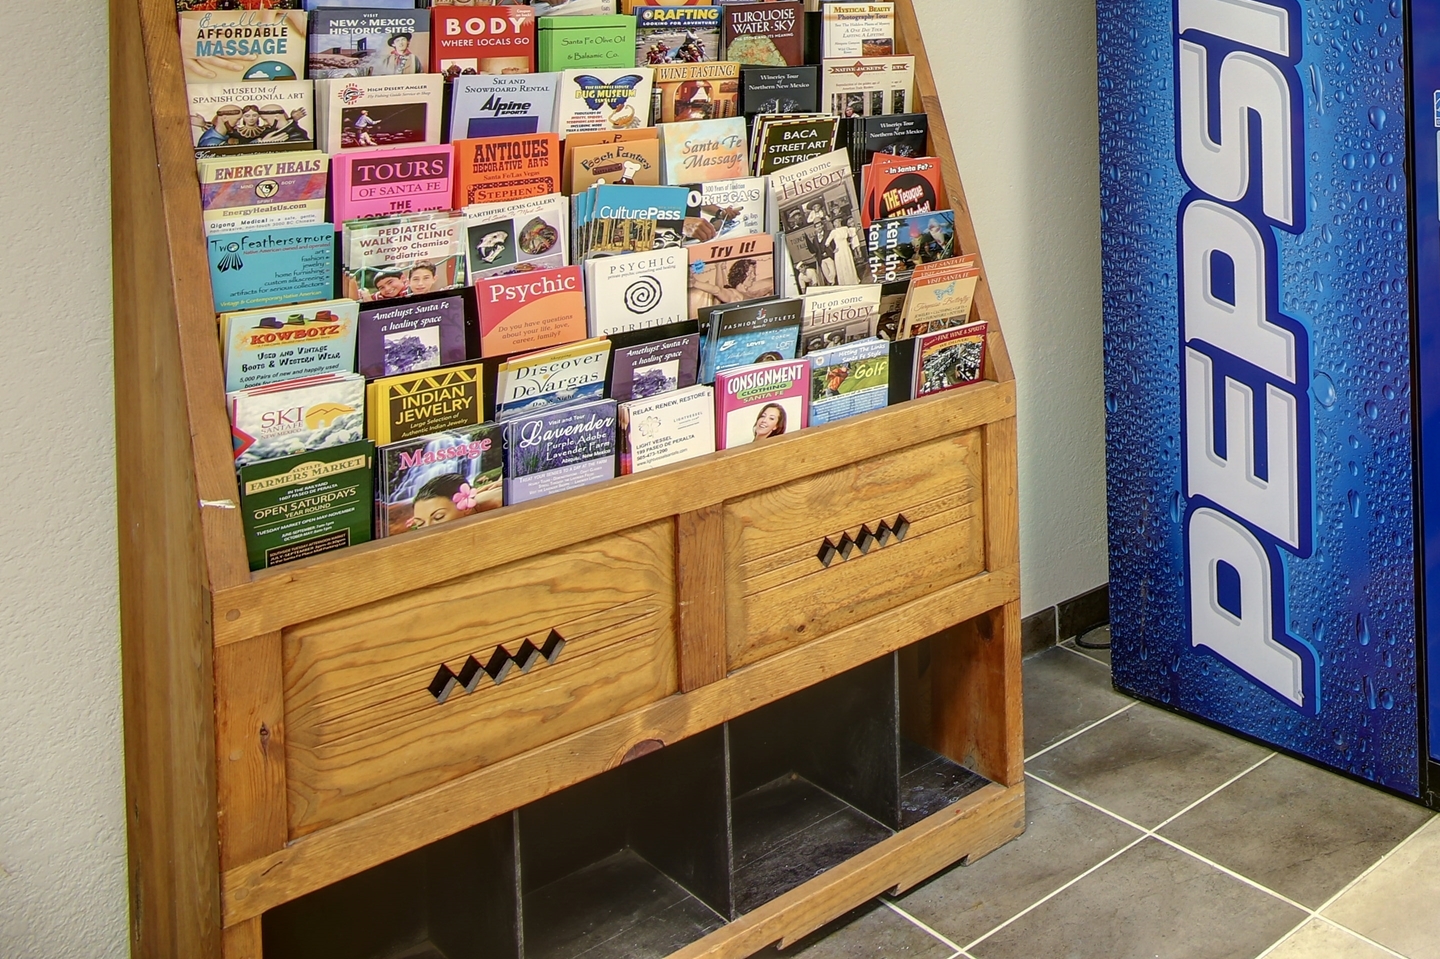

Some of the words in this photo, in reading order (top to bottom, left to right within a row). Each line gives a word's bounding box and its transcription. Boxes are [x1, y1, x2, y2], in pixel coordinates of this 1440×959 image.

[369, 18, 415, 26] MEXICO
[650, 9, 719, 20] RAFTING
[732, 8, 795, 23] TURQUOISE
[197, 27, 288, 39] AFFORDABLE
[329, 27, 382, 35] HISTORIC
[385, 26, 415, 34] SITES
[446, 17, 525, 36] BODY
[196, 39, 287, 56] MASSAGE
[441, 39, 473, 47] WHERE
[477, 38, 511, 46] LOCALS
[514, 37, 529, 45] GO
[561, 38, 584, 47] Santa
[585, 37, 593, 45] Fe
[595, 36, 612, 44] Olive
[613, 35, 625, 43] Oil
[660, 66, 688, 79] WINE
[691, 65, 736, 78] TASTING!
[192, 95, 233, 104] SPANISH
[235, 93, 284, 102] COLONIAL
[287, 92, 305, 100] ART
[222, 87, 265, 95] MUSEUM
[465, 85, 517, 93] SNOWBOARD
[518, 85, 549, 93] RENTAL
[480, 93, 531, 117] Alpine
[784, 129, 818, 140] BACA
[473, 139, 549, 163] ANTIQUES
[769, 141, 806, 154] STREET
[807, 140, 828, 150] ART
[473, 160, 523, 174] DECORATIVE
[527, 158, 548, 167] ARTS
[683, 153, 743, 168] Massage
[215, 163, 272, 181] ENERGY
[276, 160, 321, 174] HEALS
[358, 159, 444, 182] TOURS
[359, 189, 371, 198] OF
[374, 184, 422, 196] SANTA
[426, 181, 442, 191] FE
[478, 184, 545, 200] STEPHEN'S
[781, 167, 846, 200] History
[222, 202, 307, 217] EnergyHealsUs.com
[468, 209, 502, 219] EARTHFIRE
[503, 205, 525, 213] GEMS
[527, 198, 556, 209] GALLERY
[600, 206, 681, 220] CulturePass
[378, 223, 437, 236] PEDIATRIC
[360, 233, 412, 248] WALK-IN
[416, 230, 453, 241] CLINIC
[710, 244, 736, 258] Try
[739, 241, 757, 254] It!
[610, 256, 675, 274] PSYCHIC
[489, 274, 576, 303] Psychic
[373, 306, 413, 322] Amethyst
[415, 303, 438, 314] Santa
[440, 301, 450, 310] Fe
[810, 304, 874, 327] History
[251, 325, 340, 346] KOWBOYZ
[515, 353, 603, 380] Discover
[854, 360, 887, 379] Golf
[512, 372, 599, 399] DeVargas
[728, 364, 804, 394] CONSIGNMENT
[402, 385, 465, 410] INDIAN
[740, 383, 787, 397] CLOTHING
[395, 396, 473, 425] JEWELRY
[632, 406, 655, 416] RELAX,
[655, 400, 679, 412] RENEW,
[680, 392, 706, 403] RESTORE
[261, 406, 303, 429] SKI
[520, 414, 614, 448] Lavender
[547, 437, 574, 453] Purple
[576, 431, 607, 444] Adobe
[398, 438, 492, 470] Massage
[250, 471, 309, 491] FARMERS
[311, 458, 362, 477] MARKET
[254, 506, 287, 520] OPEN
[290, 488, 356, 510] SATURDAYS
